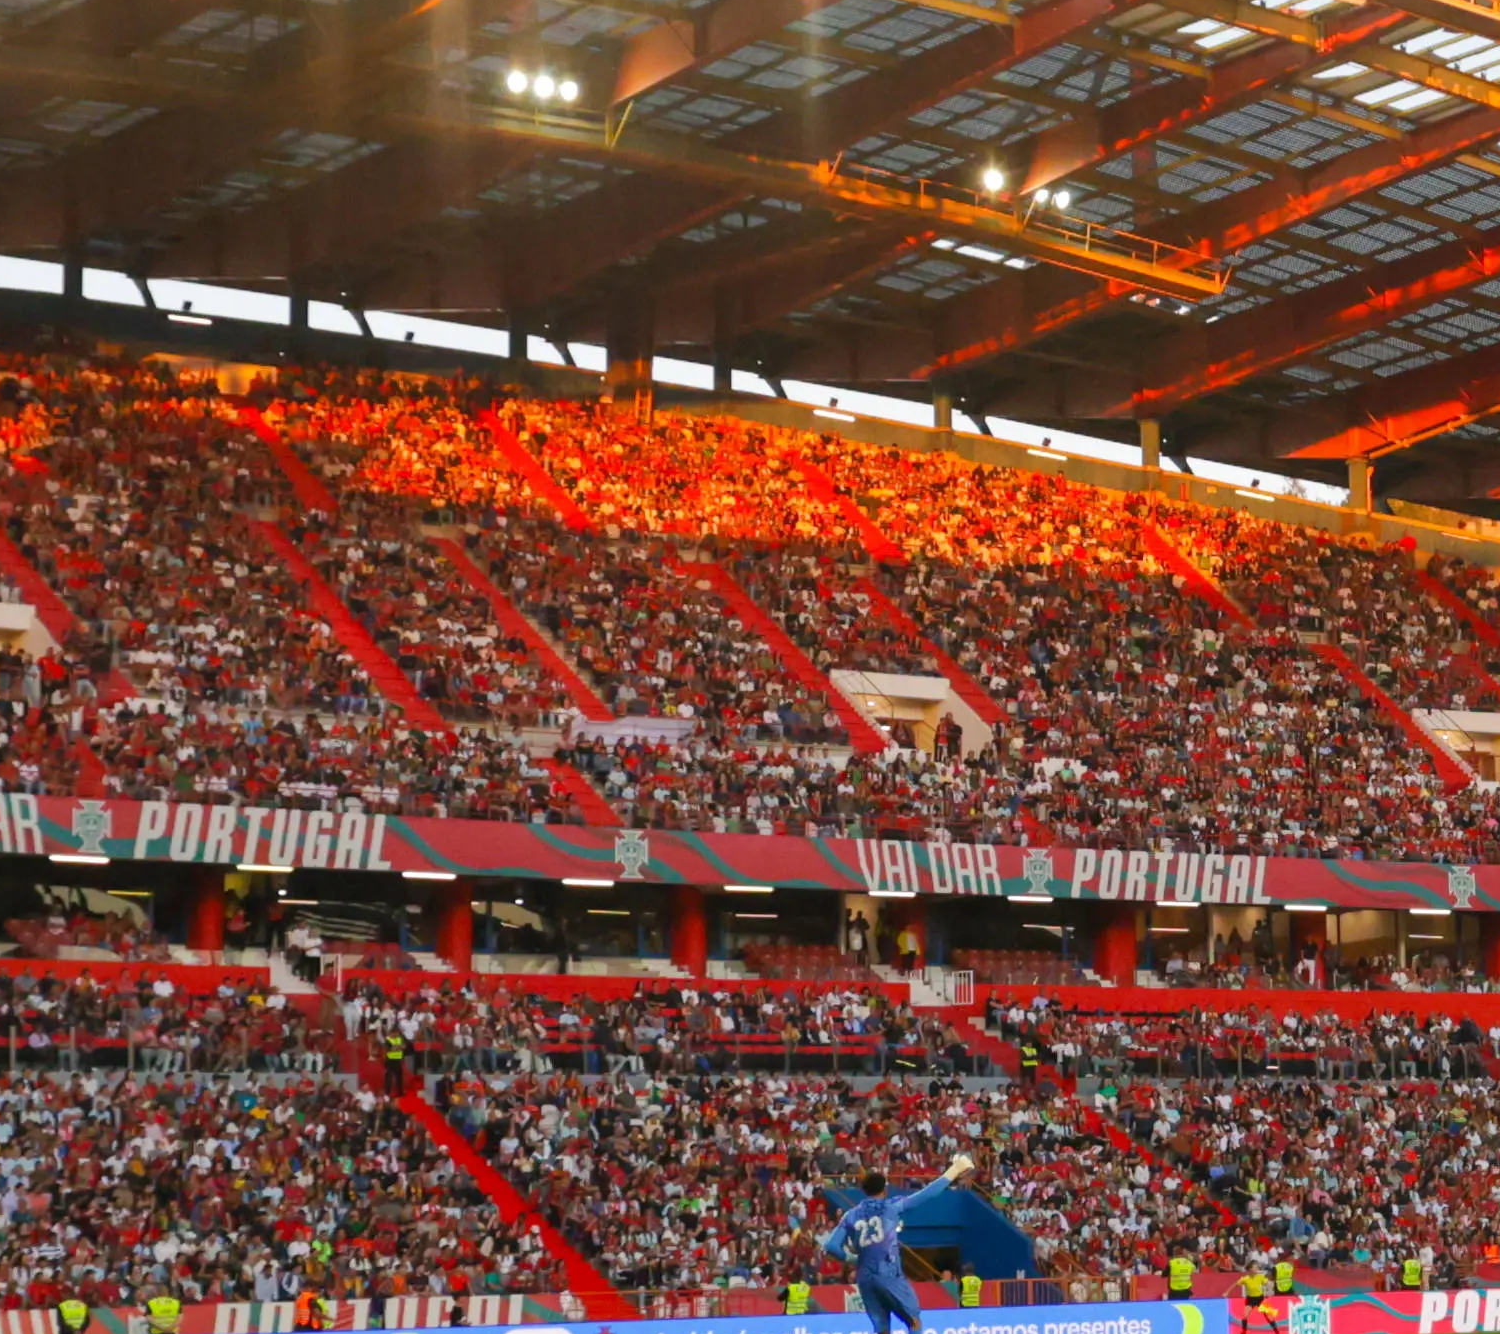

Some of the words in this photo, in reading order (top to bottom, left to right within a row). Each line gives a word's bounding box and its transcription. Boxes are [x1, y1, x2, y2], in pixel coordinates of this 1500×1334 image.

[133, 801, 392, 870] PORTUGAL
[856, 838, 920, 892] VAI
[927, 841, 1003, 896] DAR
[1071, 848, 1271, 904] PORTUGAL
[854, 1216, 885, 1247] 23
